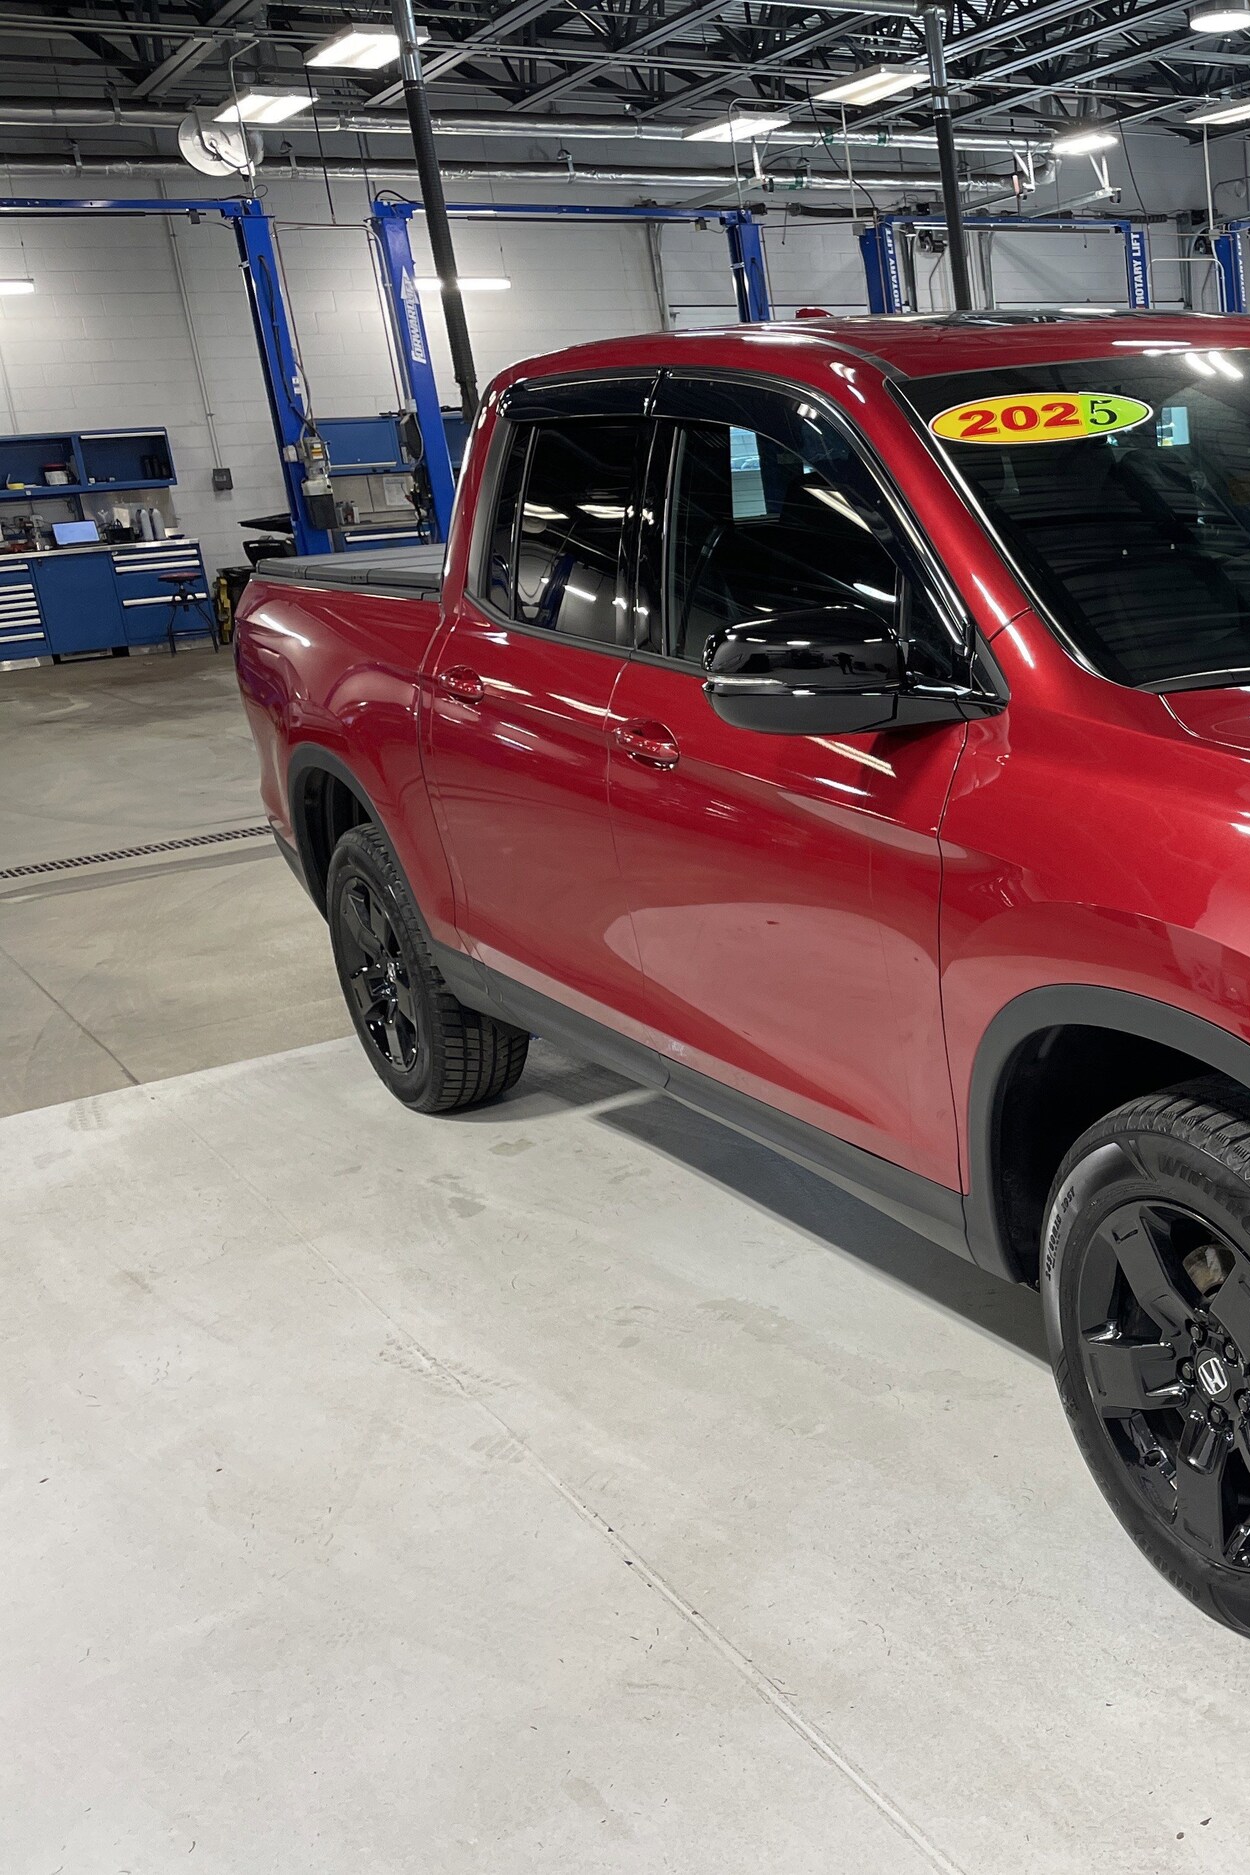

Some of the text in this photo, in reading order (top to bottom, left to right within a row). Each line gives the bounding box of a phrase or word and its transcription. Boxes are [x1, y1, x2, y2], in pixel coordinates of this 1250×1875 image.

[885, 228, 901, 307] ROTARY LIFT
[1131, 233, 1145, 305] ROTARY LIFT
[957, 399, 1118, 438] 2025
